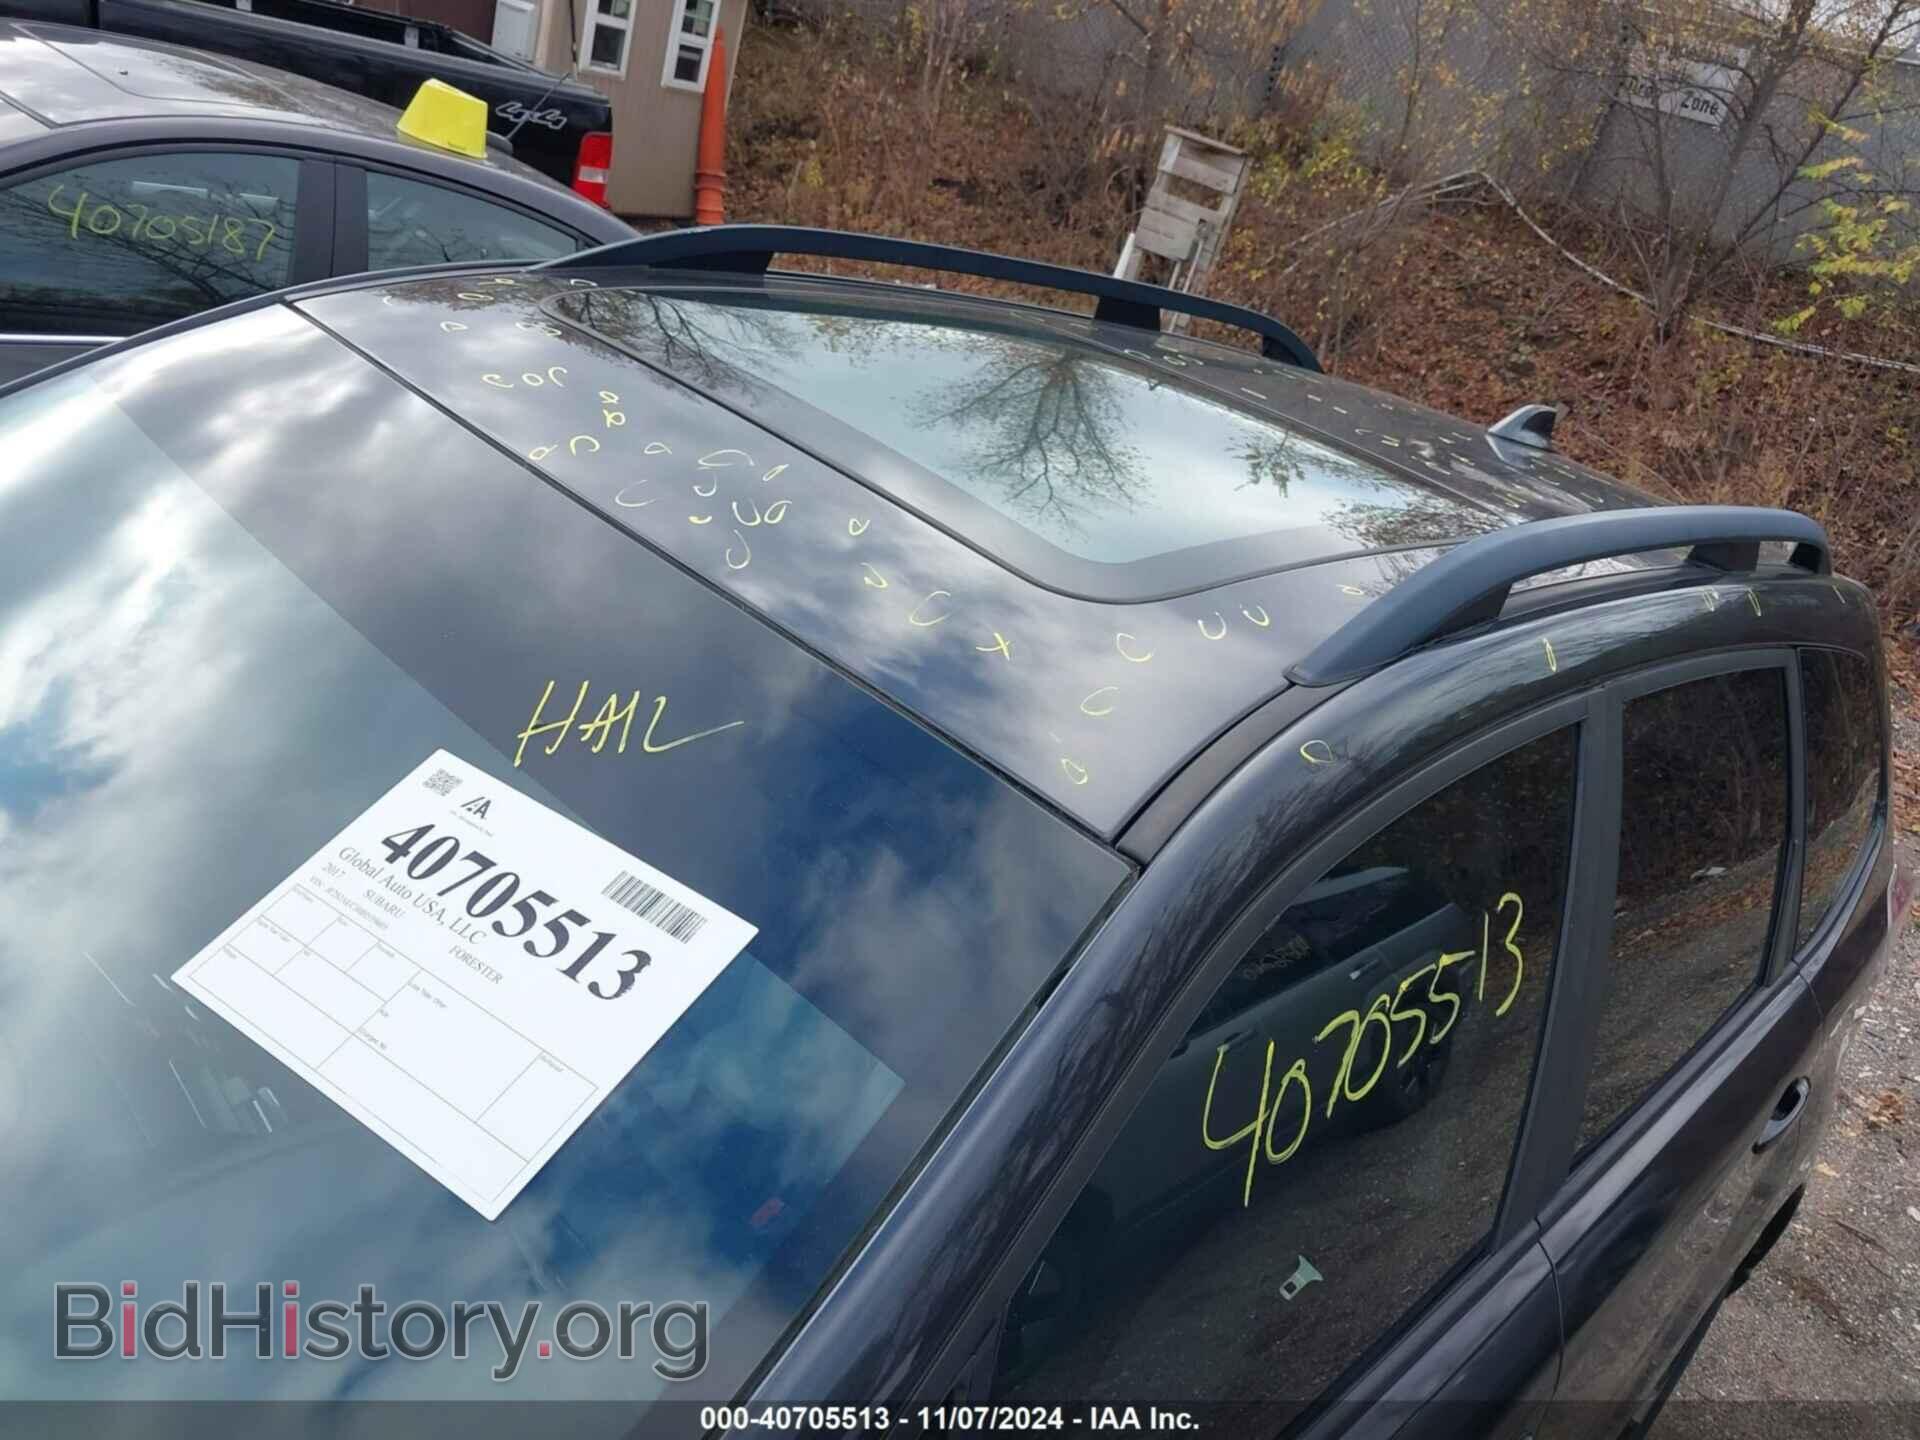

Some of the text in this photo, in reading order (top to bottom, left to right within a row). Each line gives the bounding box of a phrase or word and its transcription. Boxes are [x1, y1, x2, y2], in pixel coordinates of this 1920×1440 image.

[1681, 90, 1719, 116] Zone
[48, 184, 275, 261] 40705187
[513, 679, 745, 768] HAIL
[322, 862, 346, 879] 2017
[362, 888, 407, 920] SUBARU
[449, 944, 503, 985] FORESTER
[338, 847, 385, 880] Global
[382, 873, 412, 900] Auto
[413, 893, 447, 926] USA,
[448, 917, 487, 945] LLC
[381, 823, 652, 1000] 40705513
[1202, 892, 1524, 1208] 40705513
